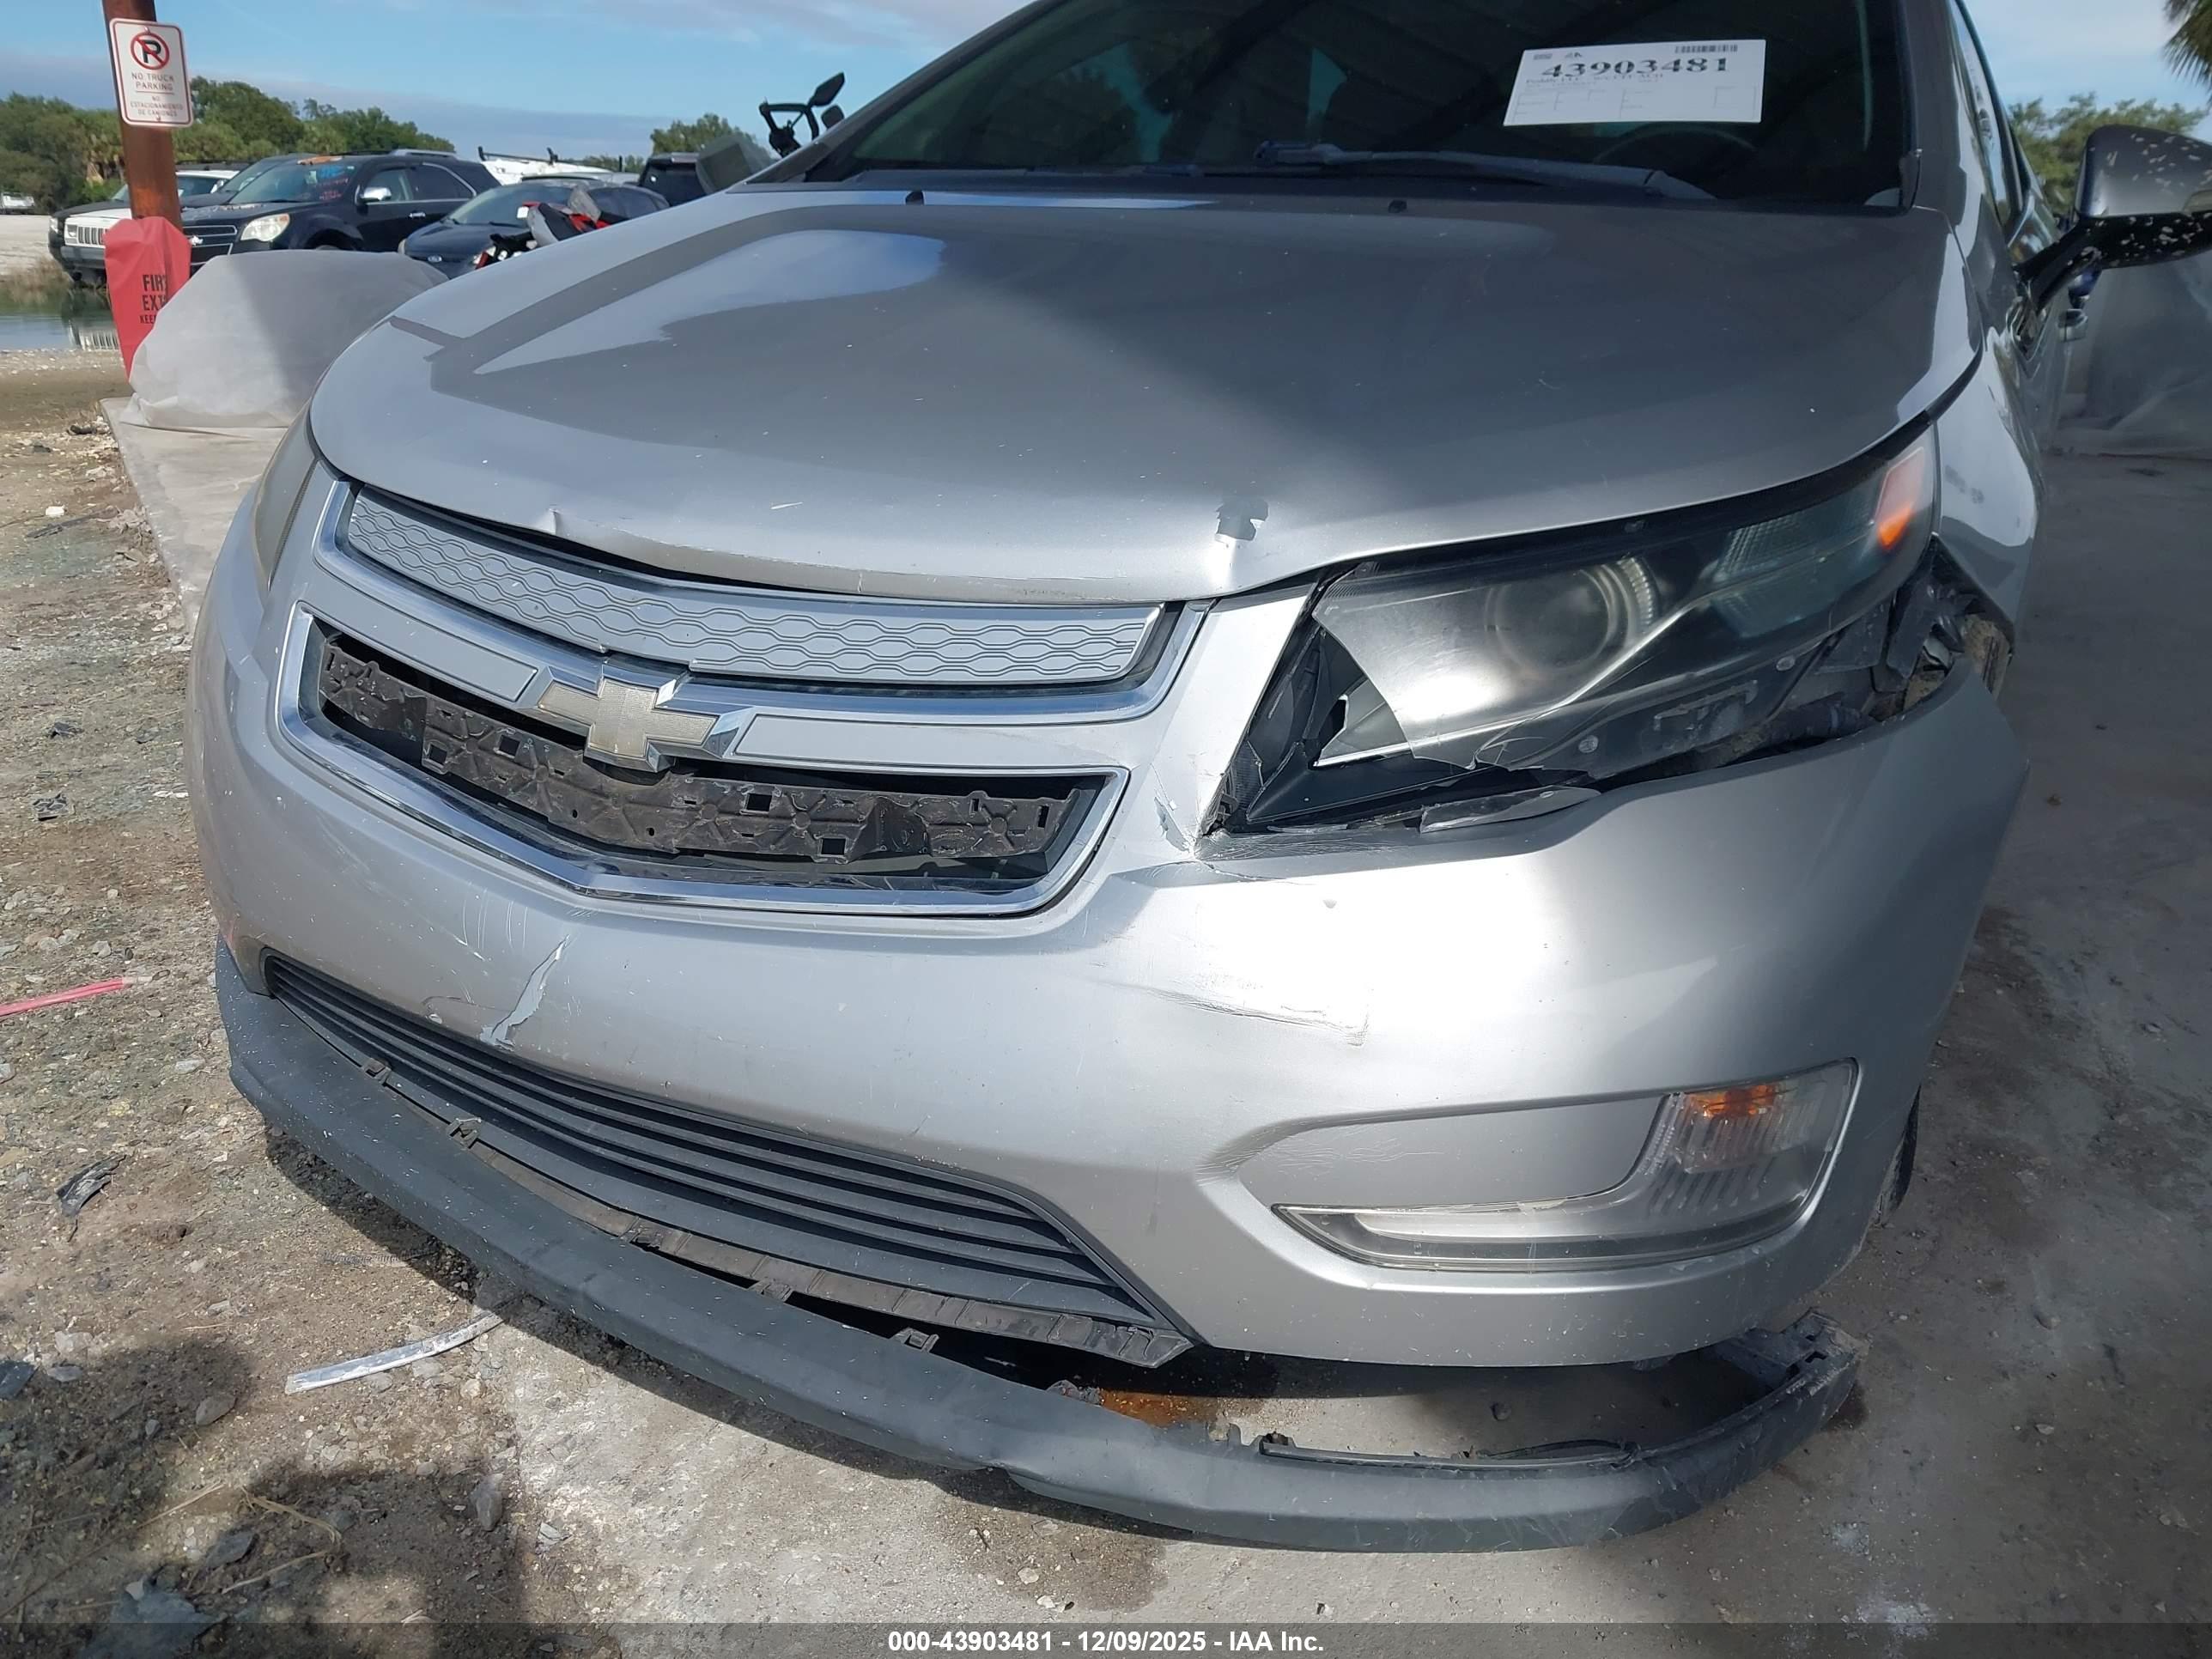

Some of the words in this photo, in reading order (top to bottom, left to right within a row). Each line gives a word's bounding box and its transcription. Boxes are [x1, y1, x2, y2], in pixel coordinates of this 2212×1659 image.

[1541, 57, 1729, 78] 43903481
[147, 73, 174, 82] TRUCK
[136, 82, 173, 91] PARKING
